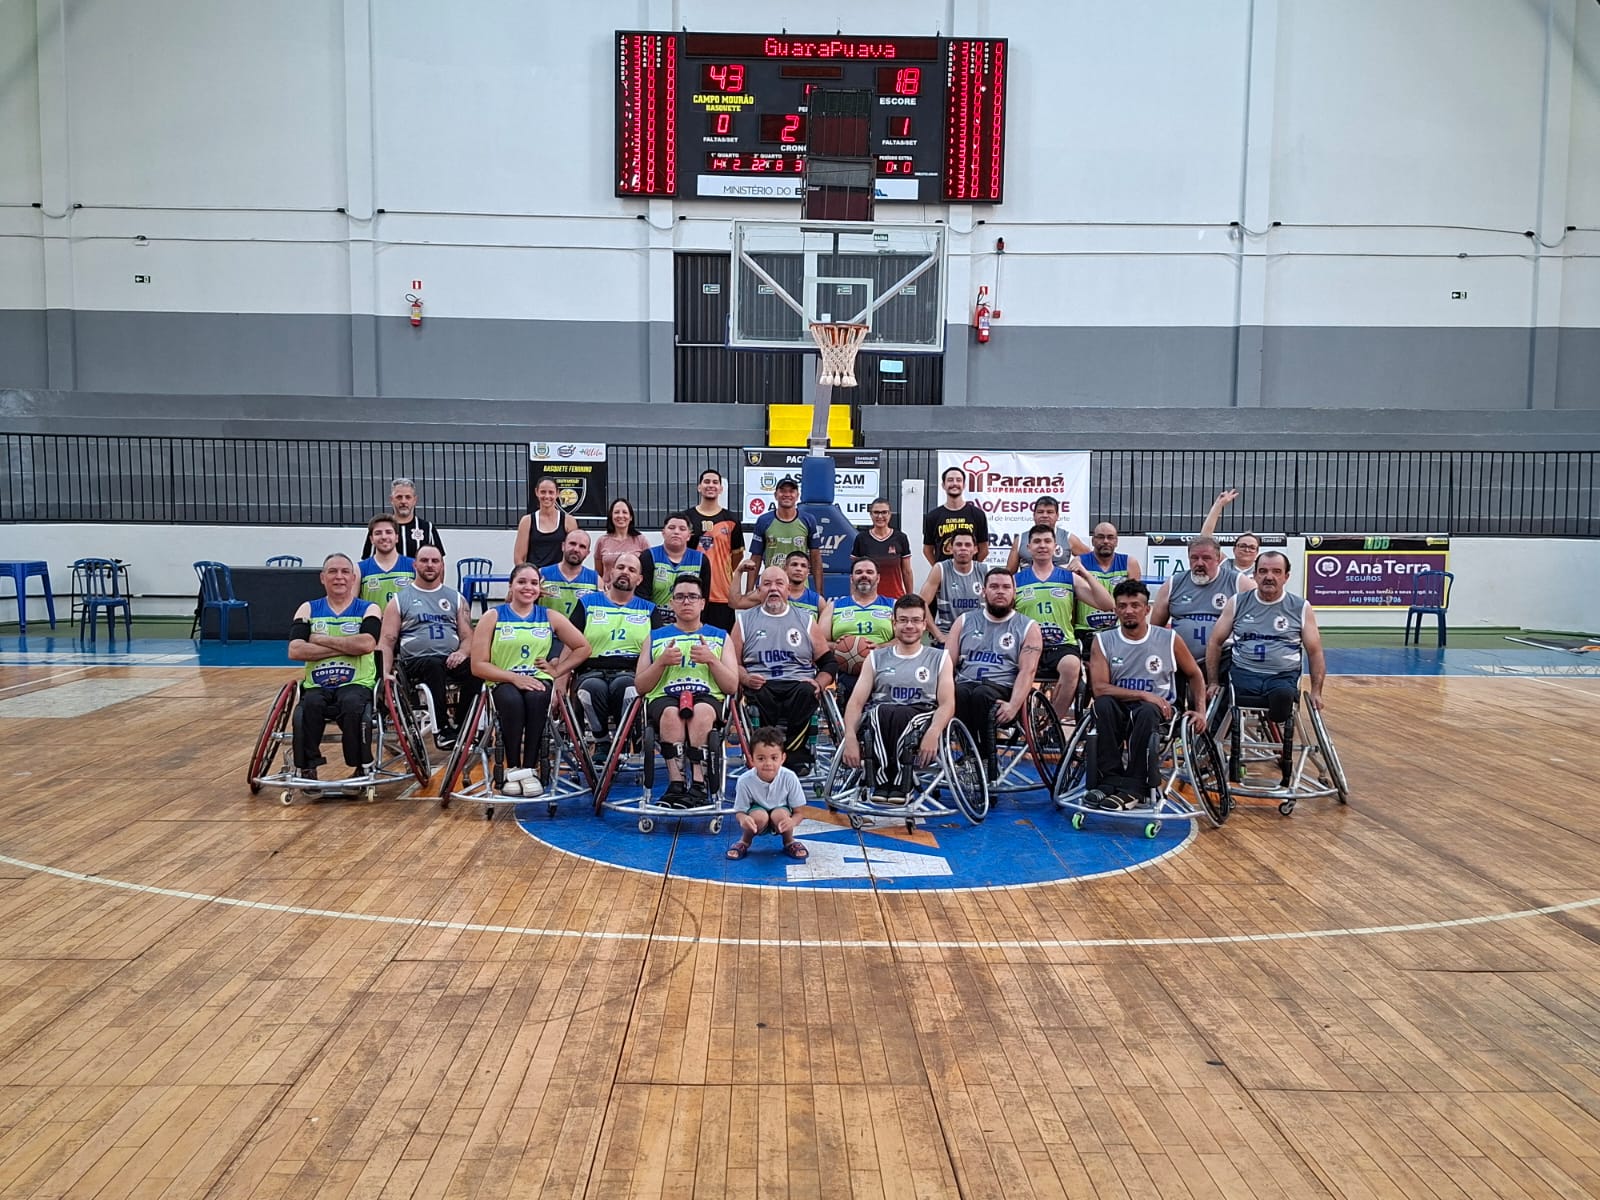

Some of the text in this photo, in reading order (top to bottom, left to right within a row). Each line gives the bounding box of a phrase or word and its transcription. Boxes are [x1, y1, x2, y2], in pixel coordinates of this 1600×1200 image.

[710, 64, 746, 91] 43
[896, 67, 920, 95] 18
[693, 93, 755, 105] CAMPO MOURÃO
[879, 97, 918, 106] ESCORE
[706, 104, 742, 112] BASQUETE
[717, 114, 730, 134] 0
[781, 115, 800, 142] 2
[903, 117, 910, 136] 1
[732, 159, 741, 171] 2
[886, 161, 894, 173] 0
[903, 162, 911, 173] 0
[723, 185, 774, 196] MINISTÉRIO
[776, 187, 792, 196] DO
[987, 472, 1065, 487] Paraná
[987, 486, 1065, 494] SUPERMERCADOS
[1346, 560, 1431, 575] Ana Terra
[952, 598, 979, 609] LOBOS
[1037, 602, 1053, 614] 15
[428, 624, 445, 640] 13
[610, 628, 626, 641] 12
[857, 621, 873, 634] 13
[1193, 626, 1206, 645] 4
[520, 644, 530, 659] 8
[968, 649, 1004, 666] LOBOS
[1253, 644, 1266, 662] 9
